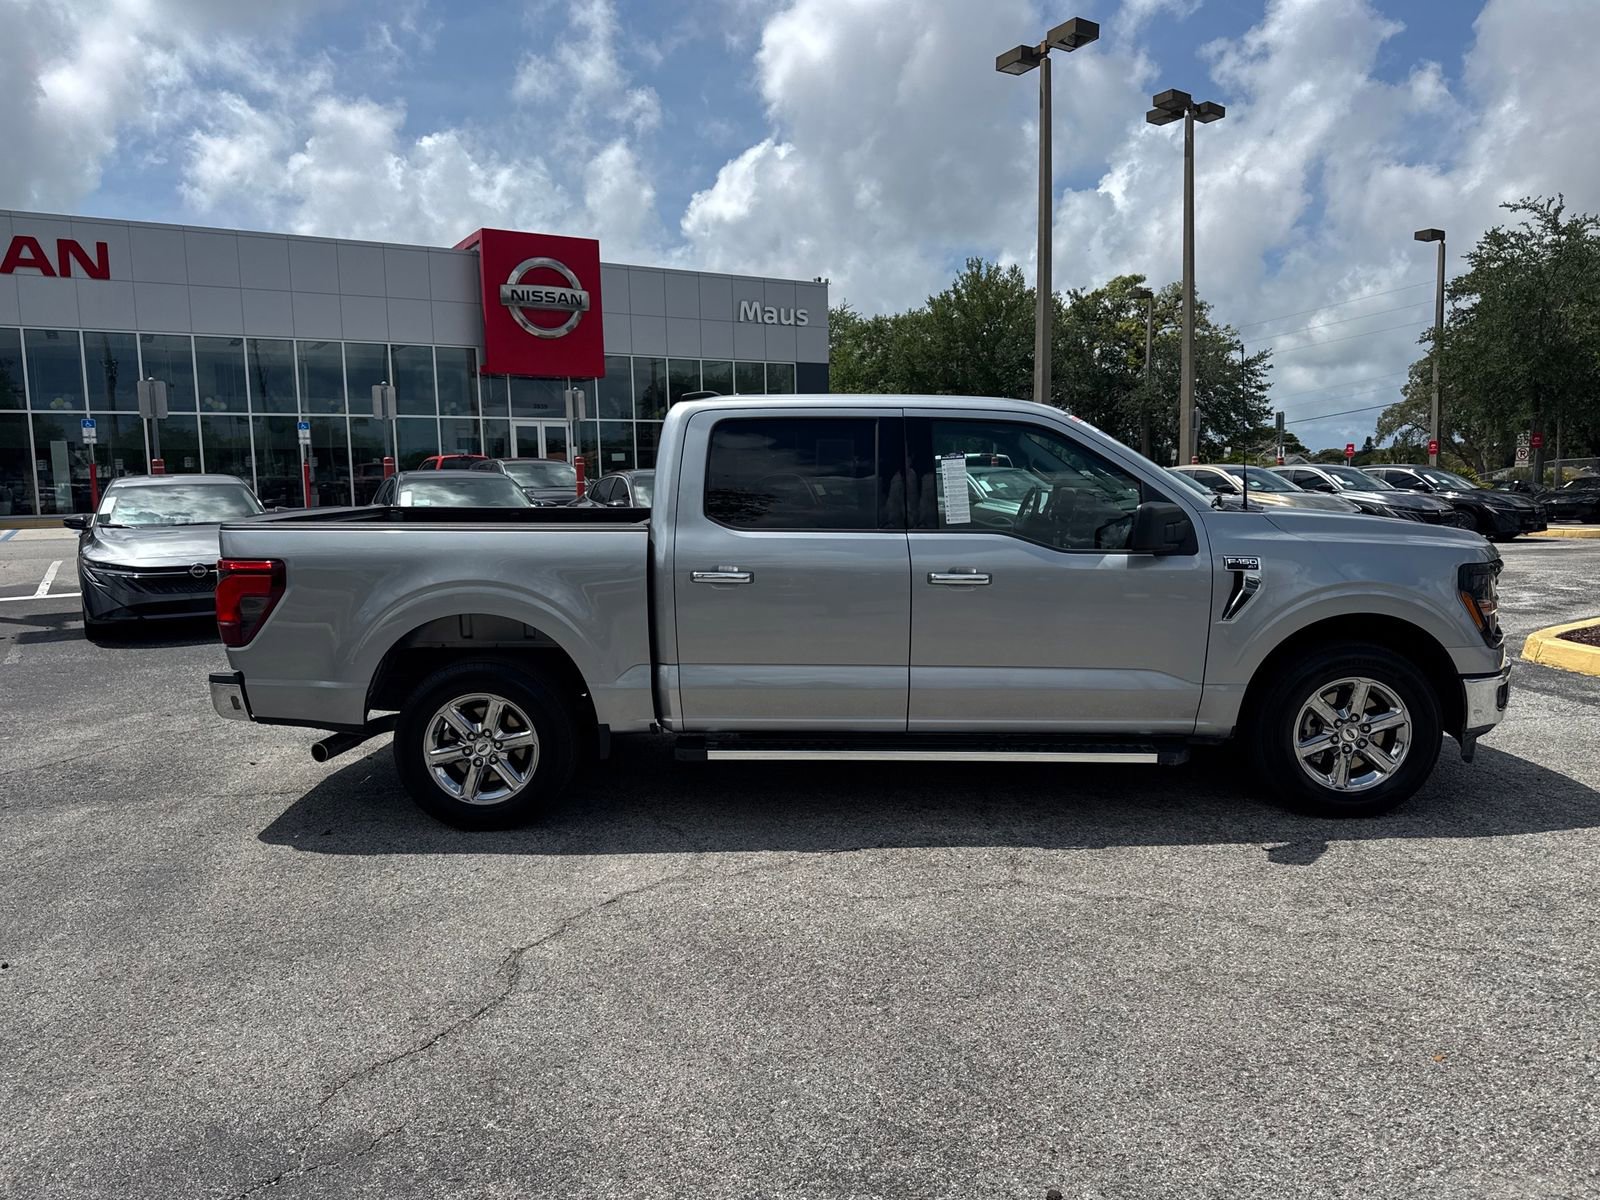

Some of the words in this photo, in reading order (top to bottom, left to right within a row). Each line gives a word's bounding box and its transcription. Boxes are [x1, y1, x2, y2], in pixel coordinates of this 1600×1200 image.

[0, 235, 110, 280] AN
[510, 289, 583, 306] NISSAN
[739, 300, 809, 326] Maus
